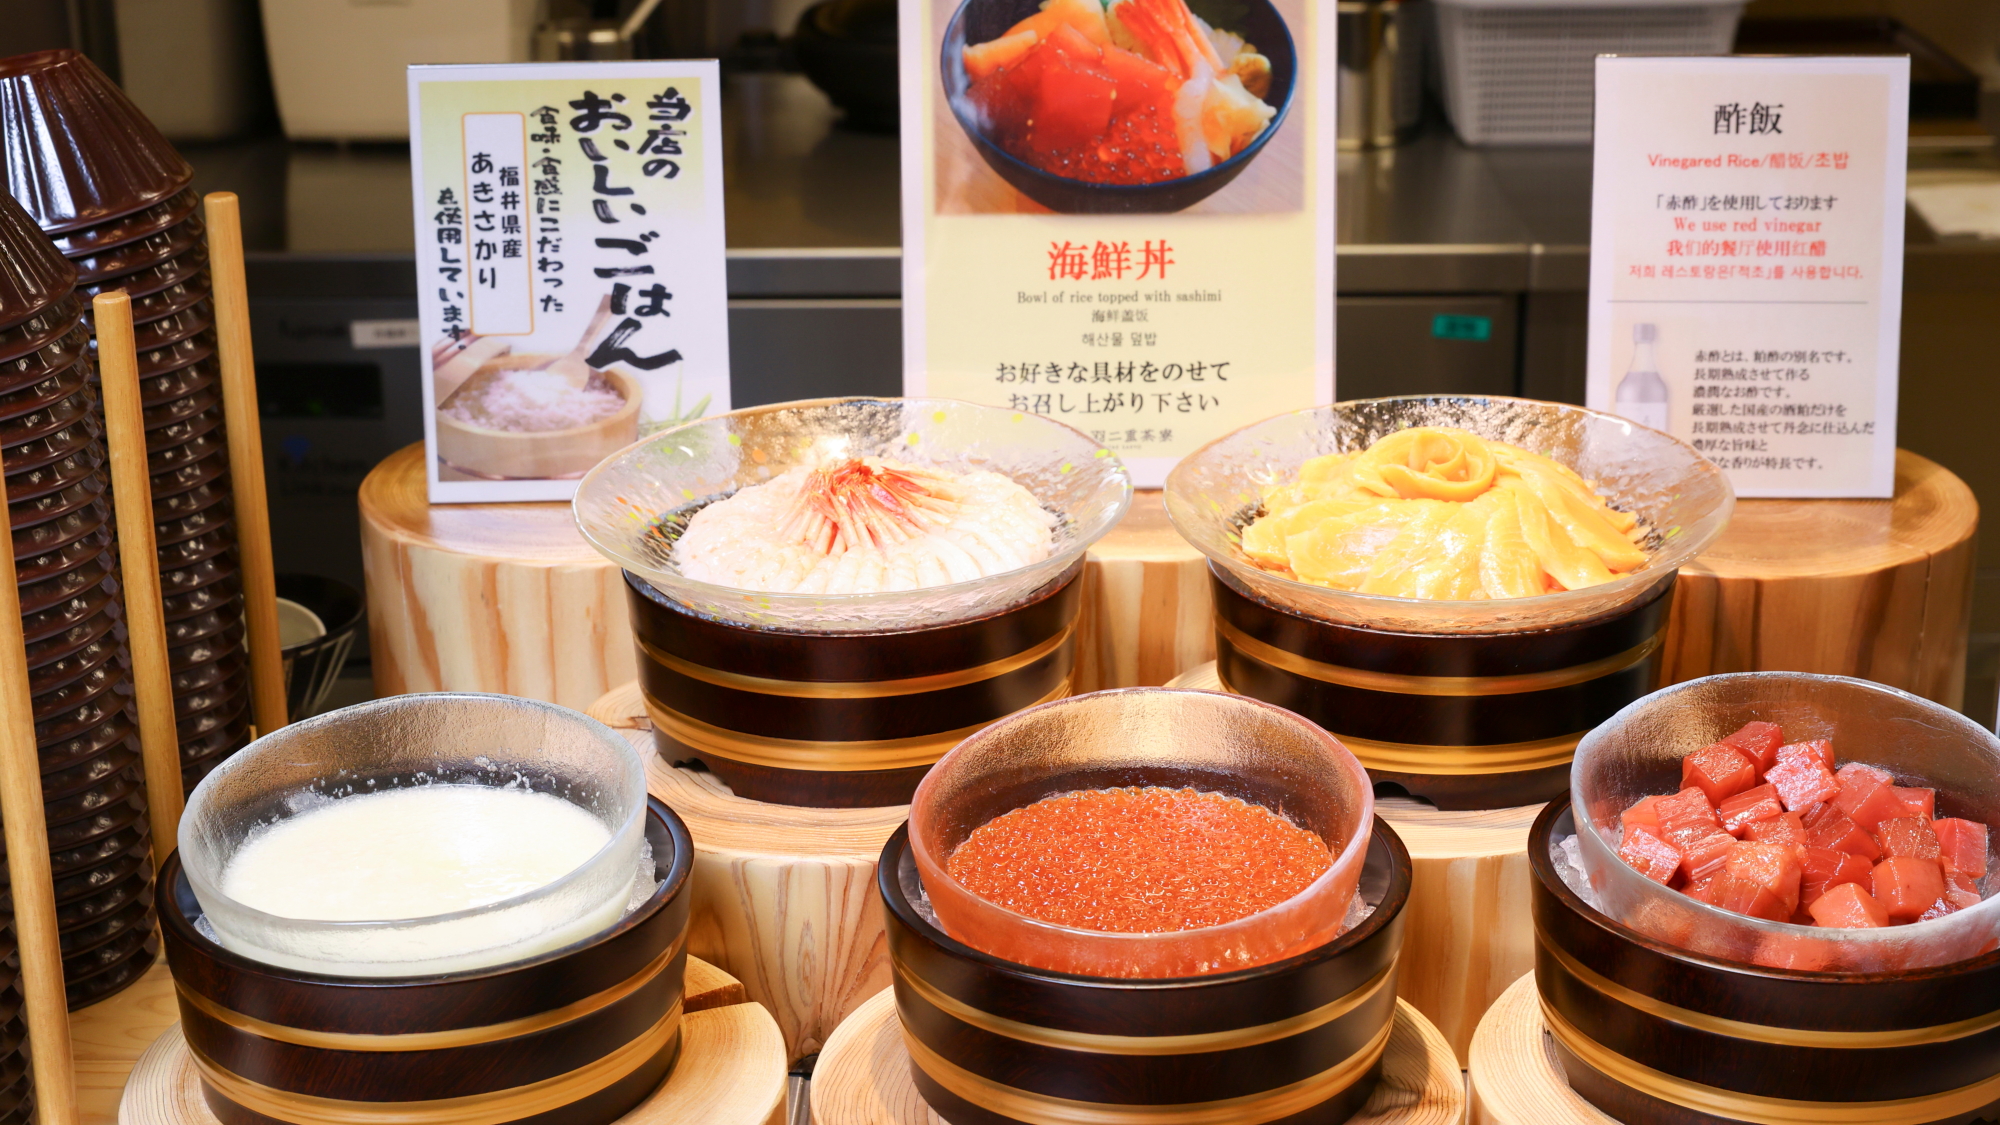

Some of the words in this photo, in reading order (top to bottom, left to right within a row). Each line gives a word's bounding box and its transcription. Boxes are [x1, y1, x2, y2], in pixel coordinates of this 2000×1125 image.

[1713, 101, 1785, 136] 酢飯
[636, 86, 692, 180] 当店の
[1647, 153, 1722, 170] Vinegared
[498, 165, 523, 260] 福井県産
[1655, 194, 1839, 211] 「赤酢」を使用しております
[470, 152, 498, 290] あきさかり
[568, 90, 684, 371] おいしいごはん
[1673, 217, 1696, 232] We
[1702, 219, 1727, 232] use
[1733, 217, 1757, 232] red
[1764, 217, 1822, 234] vinegar
[1667, 239, 1827, 257] 我们的餐厅使用红醋
[434, 187, 467, 351] を使用しています。
[1046, 239, 1176, 281] 海鮮丼
[1629, 265, 1656, 280] 저희
[1791, 264, 1864, 280] 사용합니다.
[1017, 291, 1047, 304] Bowl
[1052, 291, 1065, 304] of
[1070, 291, 1093, 304] rice
[1098, 291, 1139, 306] topped
[1144, 290, 1171, 304] with
[1176, 289, 1222, 303] sashimi
[1081, 331, 1124, 347] 해산물
[1130, 331, 1157, 347] 덮밥
[995, 361, 1231, 384] お好きな具材をのせて
[1008, 392, 1220, 415] お召し上がり下さい
